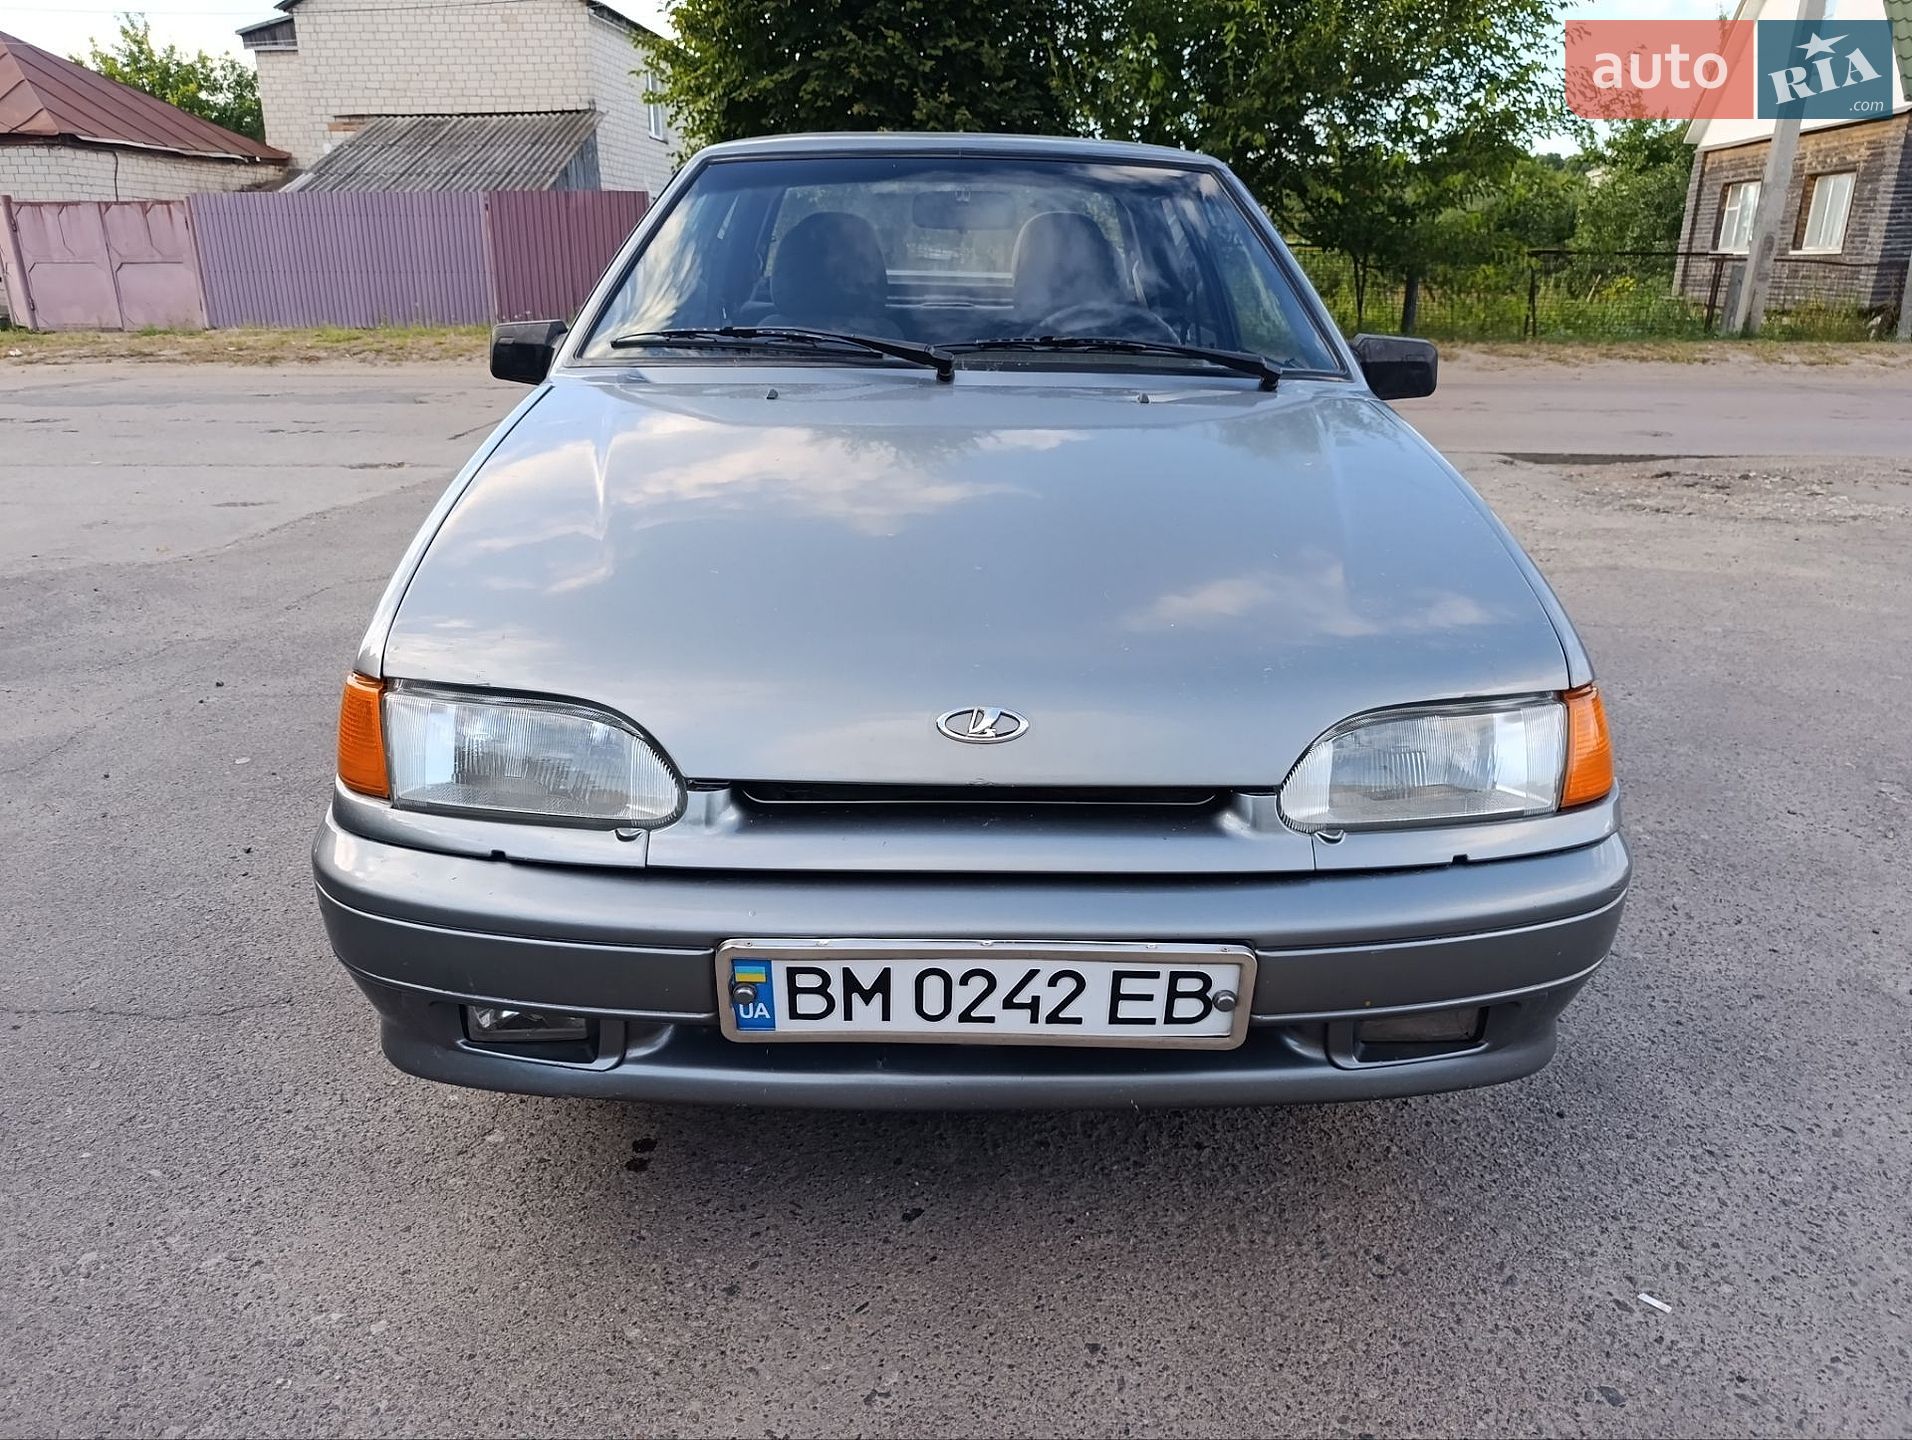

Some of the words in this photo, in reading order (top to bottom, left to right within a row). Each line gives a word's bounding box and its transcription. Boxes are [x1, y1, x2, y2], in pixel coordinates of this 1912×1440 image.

[739, 1003, 771, 1020] UA
[786, 966, 891, 1022] BM
[913, 967, 1086, 1025] 0242
[1108, 969, 1214, 1026] EB
